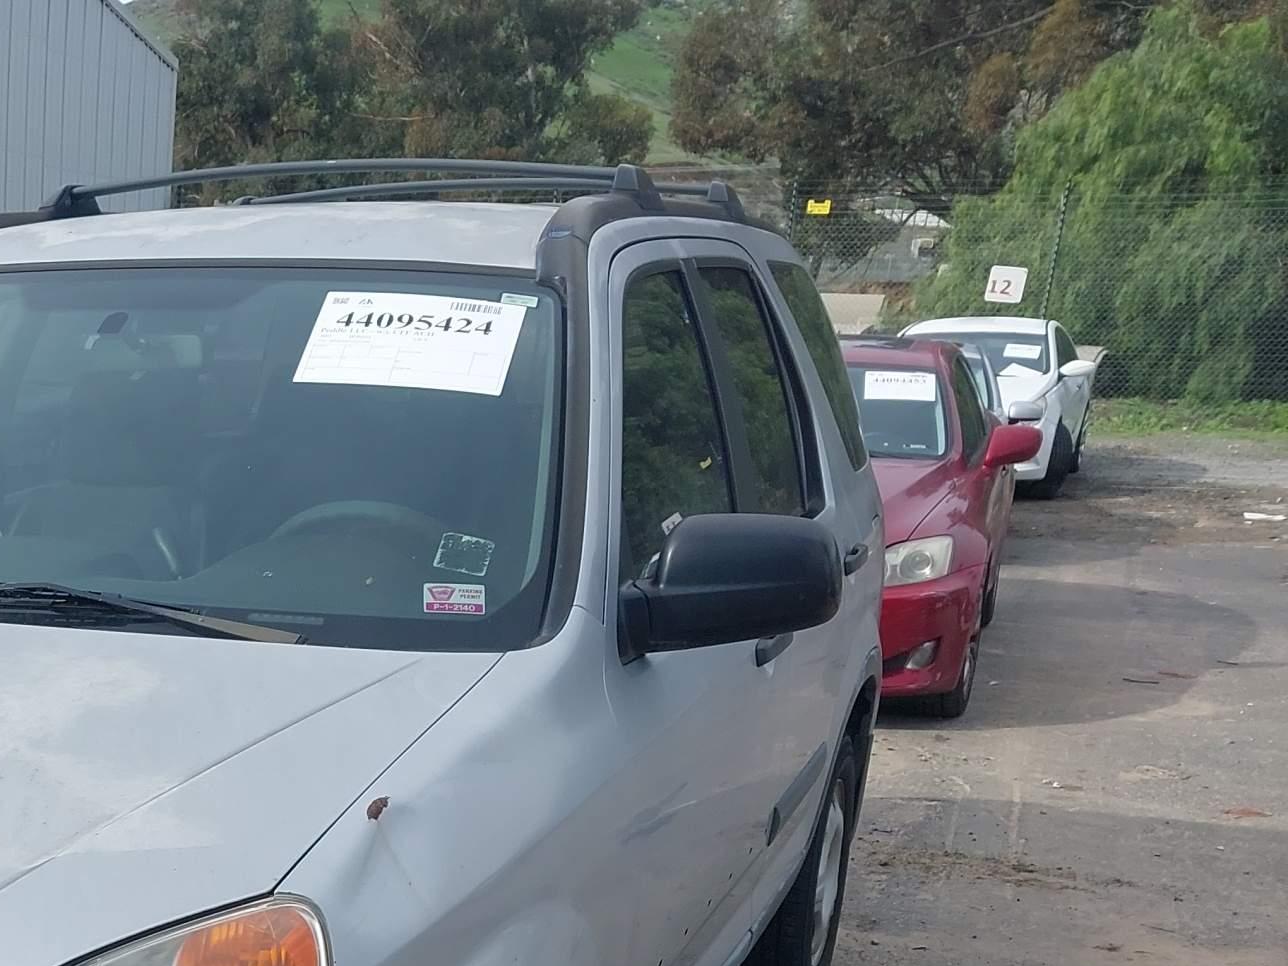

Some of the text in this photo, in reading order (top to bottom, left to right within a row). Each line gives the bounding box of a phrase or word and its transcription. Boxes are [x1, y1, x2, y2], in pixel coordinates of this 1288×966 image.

[988, 279, 1013, 296] 12
[335, 311, 493, 337] 44095424
[433, 603, 476, 612] P-1-2140
